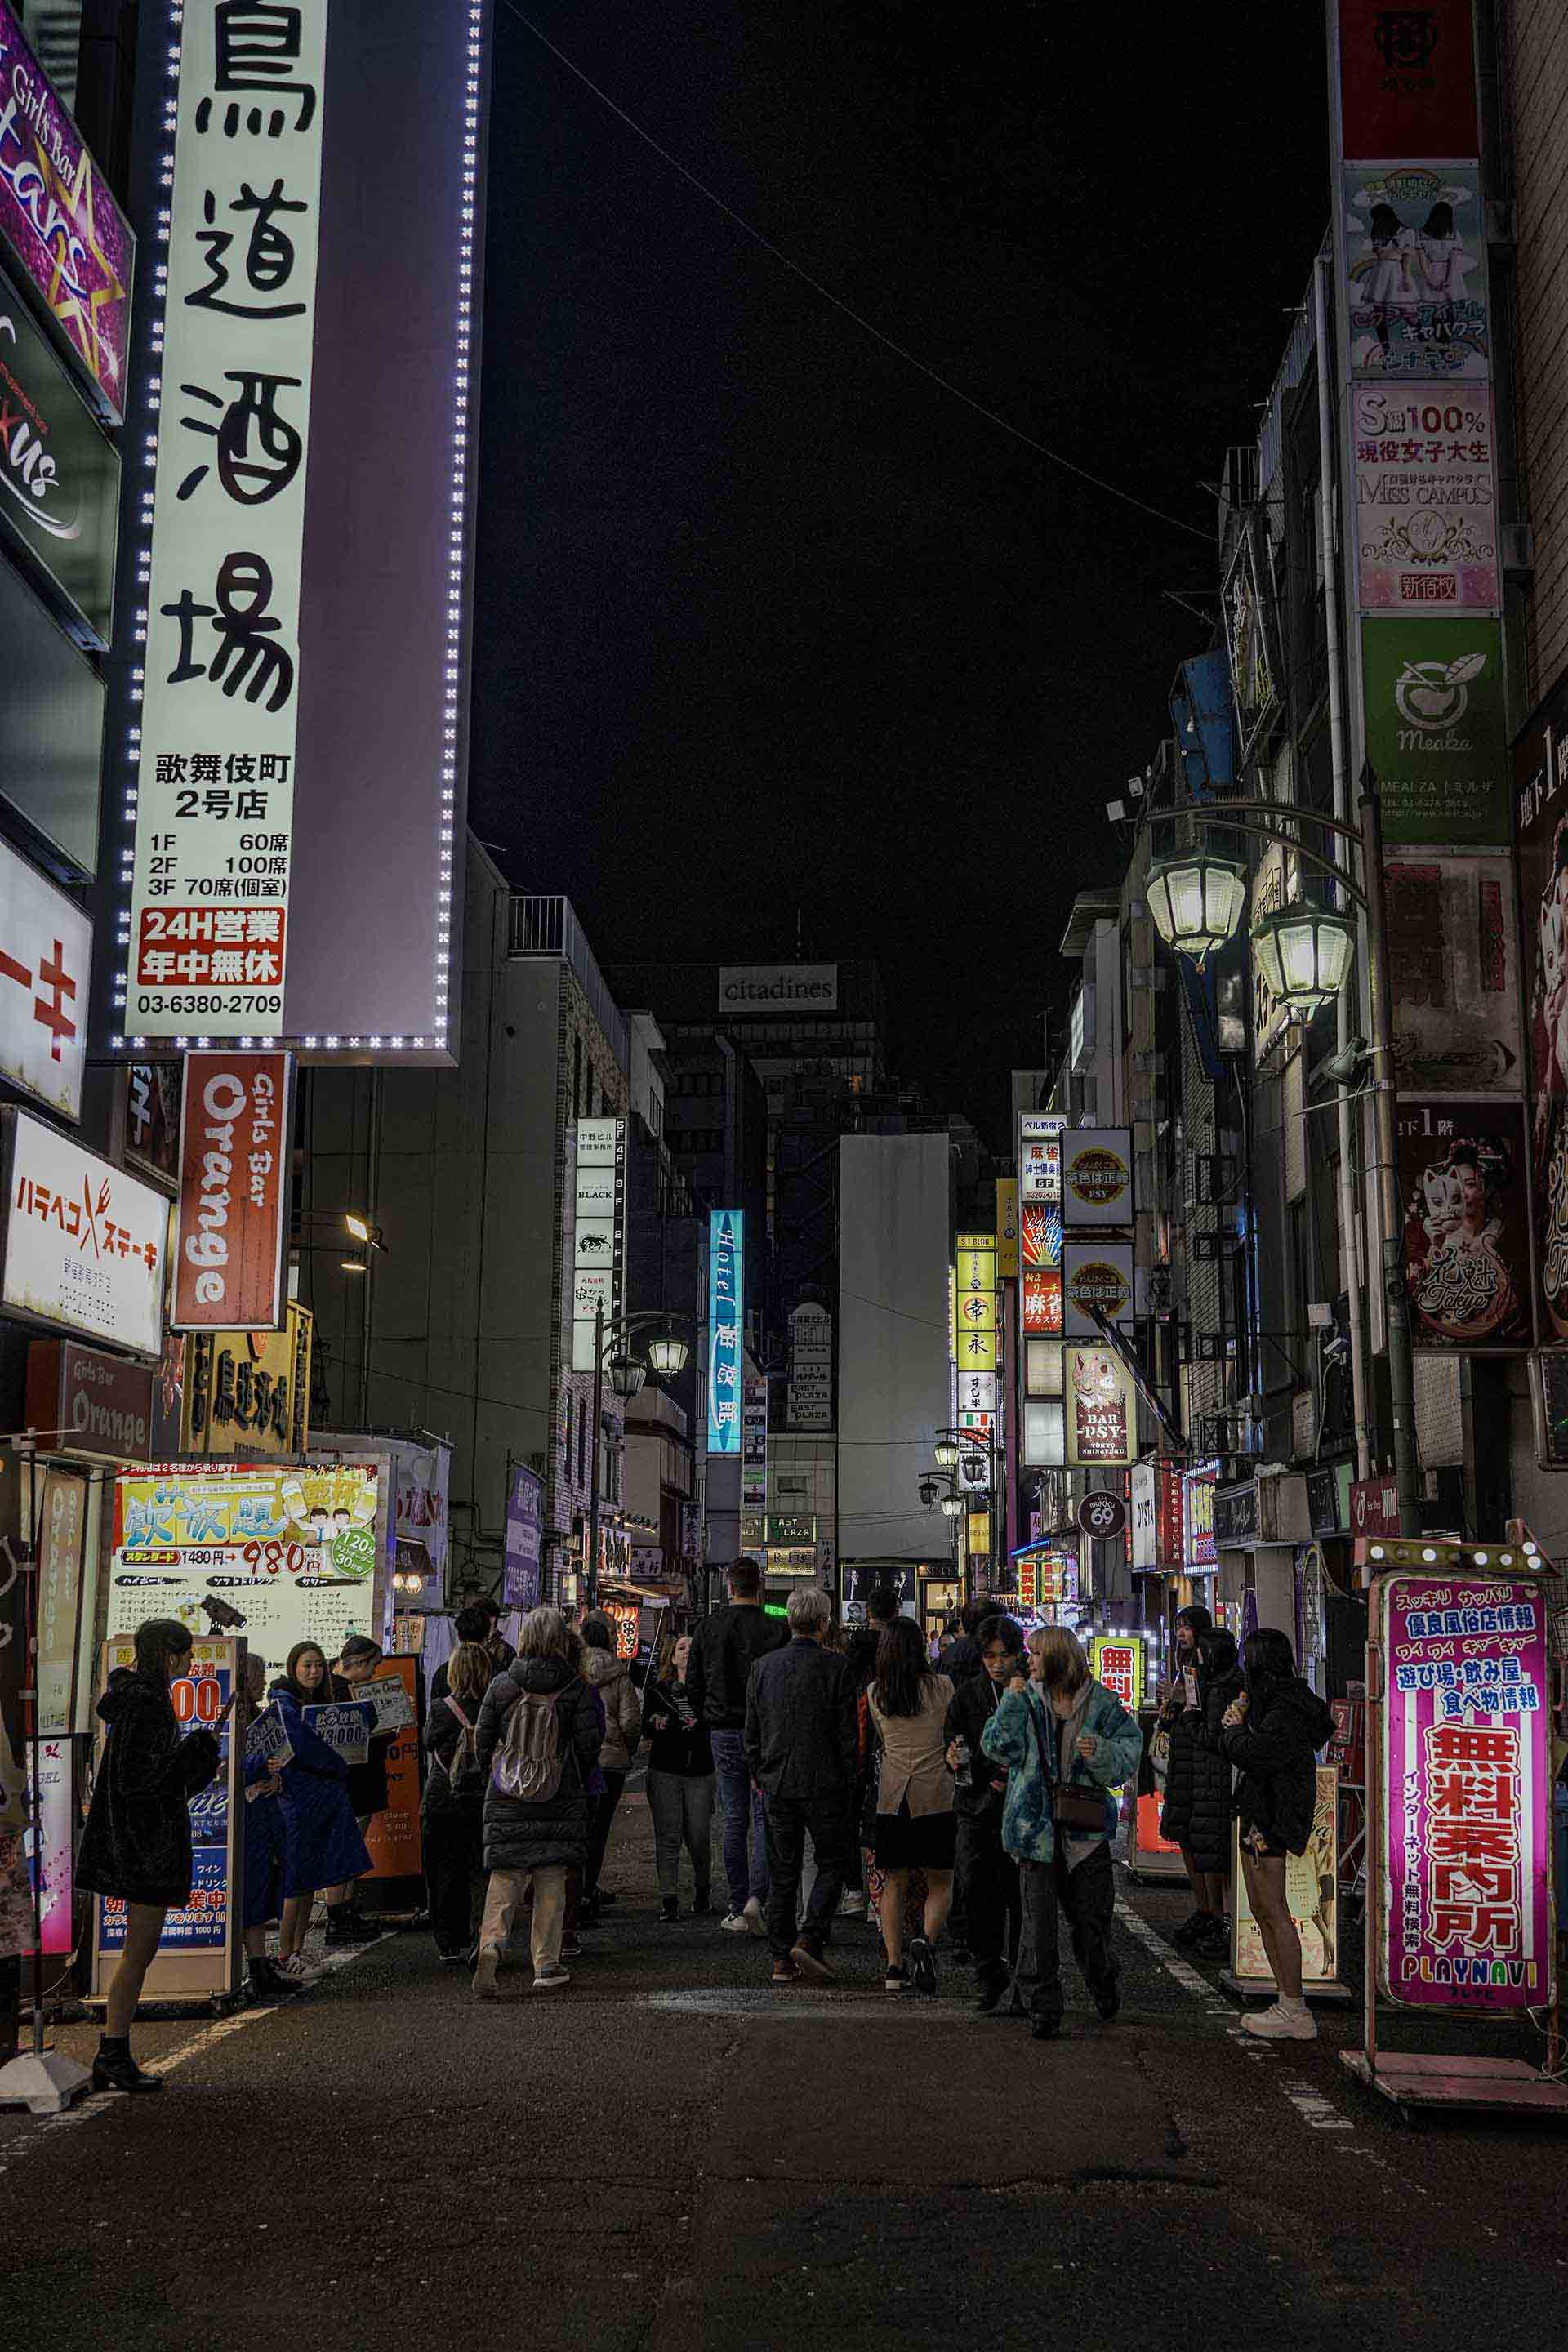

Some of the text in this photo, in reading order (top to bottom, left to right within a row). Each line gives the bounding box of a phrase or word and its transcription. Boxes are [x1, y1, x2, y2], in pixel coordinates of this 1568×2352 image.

[1357, 441, 1490, 465] 現役女子大生
[155, 753, 292, 785] 歌舞伎町
[175, 791, 269, 821] 2号店
[150, 833, 289, 853] 1F 60席
[149, 856, 288, 875] 2F 100席
[147, 878, 287, 898] 3F 70席(個室)
[143, 911, 281, 943] 24H営業
[141, 950, 279, 982] 年中無休
[137, 996, 282, 1013] 03-6380-2709
[1031, 1145, 1059, 1160] 麻雀
[185, 1071, 247, 1305] Orange
[102, 1219, 158, 1272] ステーキ
[717, 1227, 736, 1307] Hotel
[967, 1333, 990, 1355] 永
[71, 1388, 146, 1449] Orange
[1084, 1425, 1122, 1439] PSY
[1087, 1414, 1118, 1424] BAR
[125, 1481, 290, 1548] 飲み放題
[1090, 1507, 1115, 1526] 69
[181, 1550, 225, 1566] 1480円
[1396, 1586, 1513, 1611] スッキリ サッパリ
[1406, 1604, 1536, 1640] 優良風俗店情報
[1396, 1655, 1522, 1692] 遊び場・飲み屋
[1442, 1684, 1541, 1717] 食べ物情報
[1425, 1723, 1521, 1952] 無料案内所
[196, 1864, 222, 1874] ワイン
[1402, 1770, 1422, 1949] インターネット無料検索
[1401, 1954, 1539, 1989] PLAYNAVI
